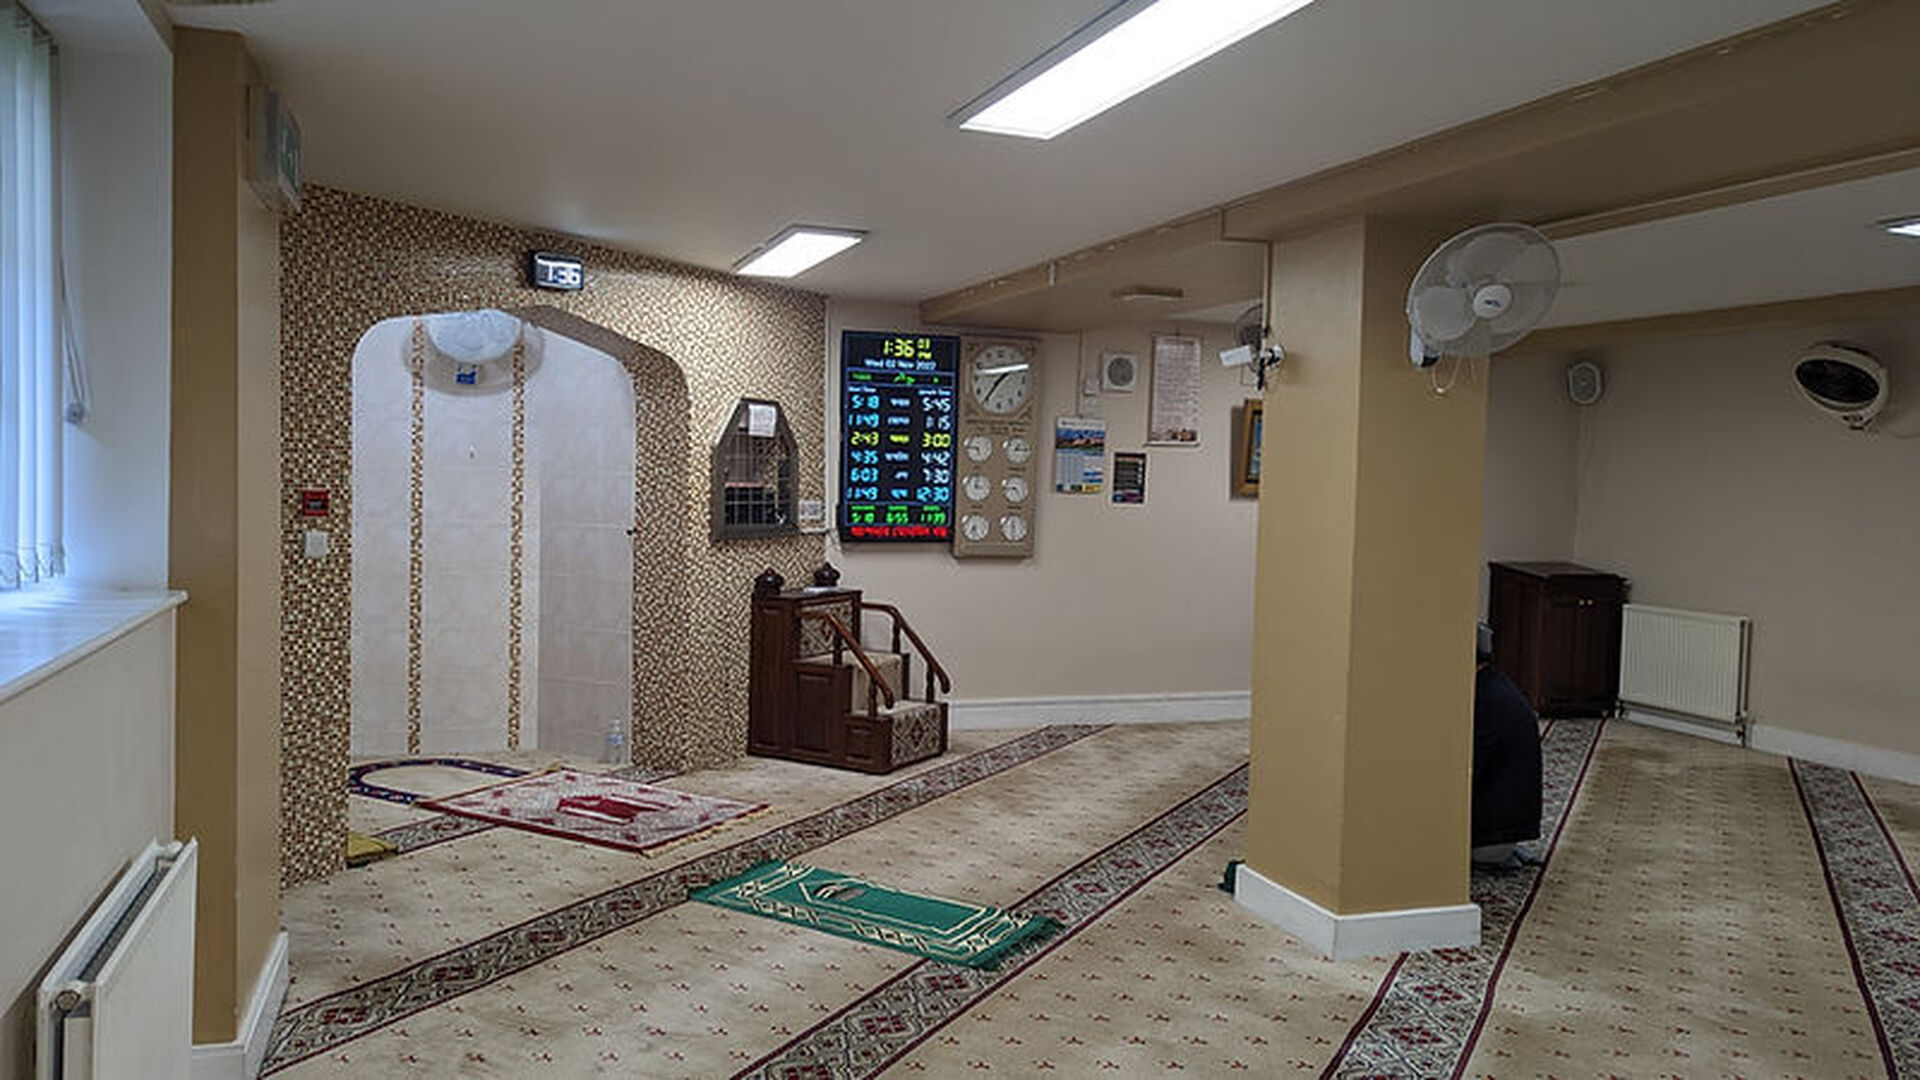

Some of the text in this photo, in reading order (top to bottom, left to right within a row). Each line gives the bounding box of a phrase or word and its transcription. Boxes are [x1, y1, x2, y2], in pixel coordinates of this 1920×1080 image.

[883, 338, 915, 358] 1:36
[851, 395, 880, 409] 5:18
[922, 397, 951, 412] 5:45
[926, 415, 951, 430] 1:15
[851, 431, 879, 446] 2:43
[921, 432, 951, 448] 3:00
[851, 449, 878, 464] 4:35
[921, 451, 950, 467] 4:42
[851, 467, 878, 482] 6:03
[922, 468, 949, 484] 7:30
[916, 487, 949, 502] 12:30
